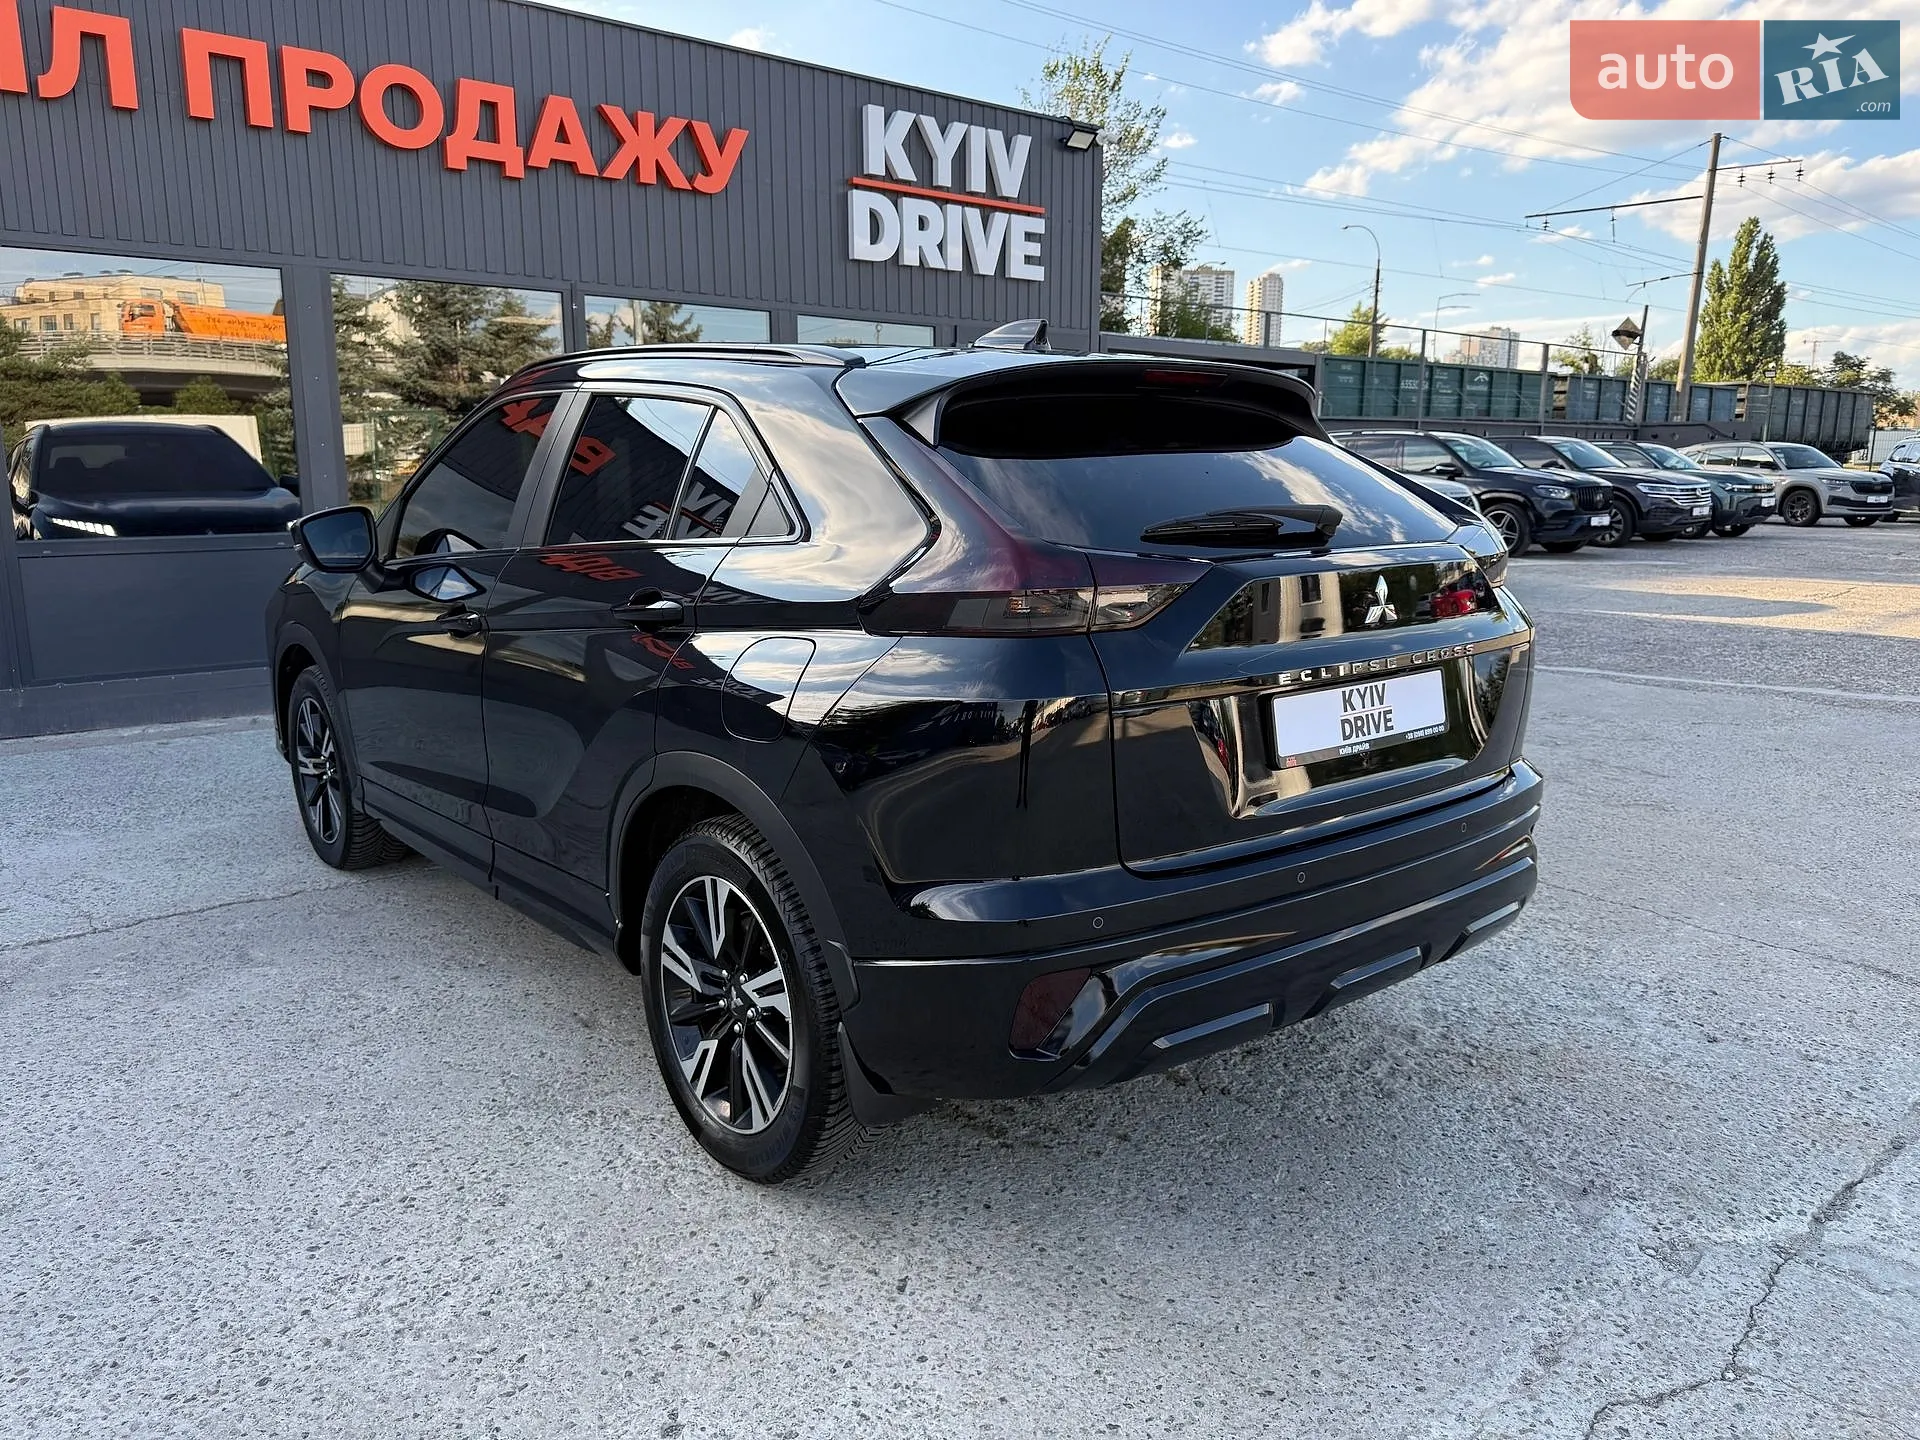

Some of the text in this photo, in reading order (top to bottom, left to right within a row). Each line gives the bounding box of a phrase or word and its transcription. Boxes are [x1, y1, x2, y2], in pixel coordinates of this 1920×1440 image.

[181, 27, 749, 194] ПРОДАЖУ
[862, 104, 1032, 199] KYIV
[848, 189, 1046, 282] DRIVE
[1278, 644, 1474, 685] ECLIPSE CROSS
[1341, 683, 1387, 713] KYIV
[1340, 708, 1394, 742] DRIVE
